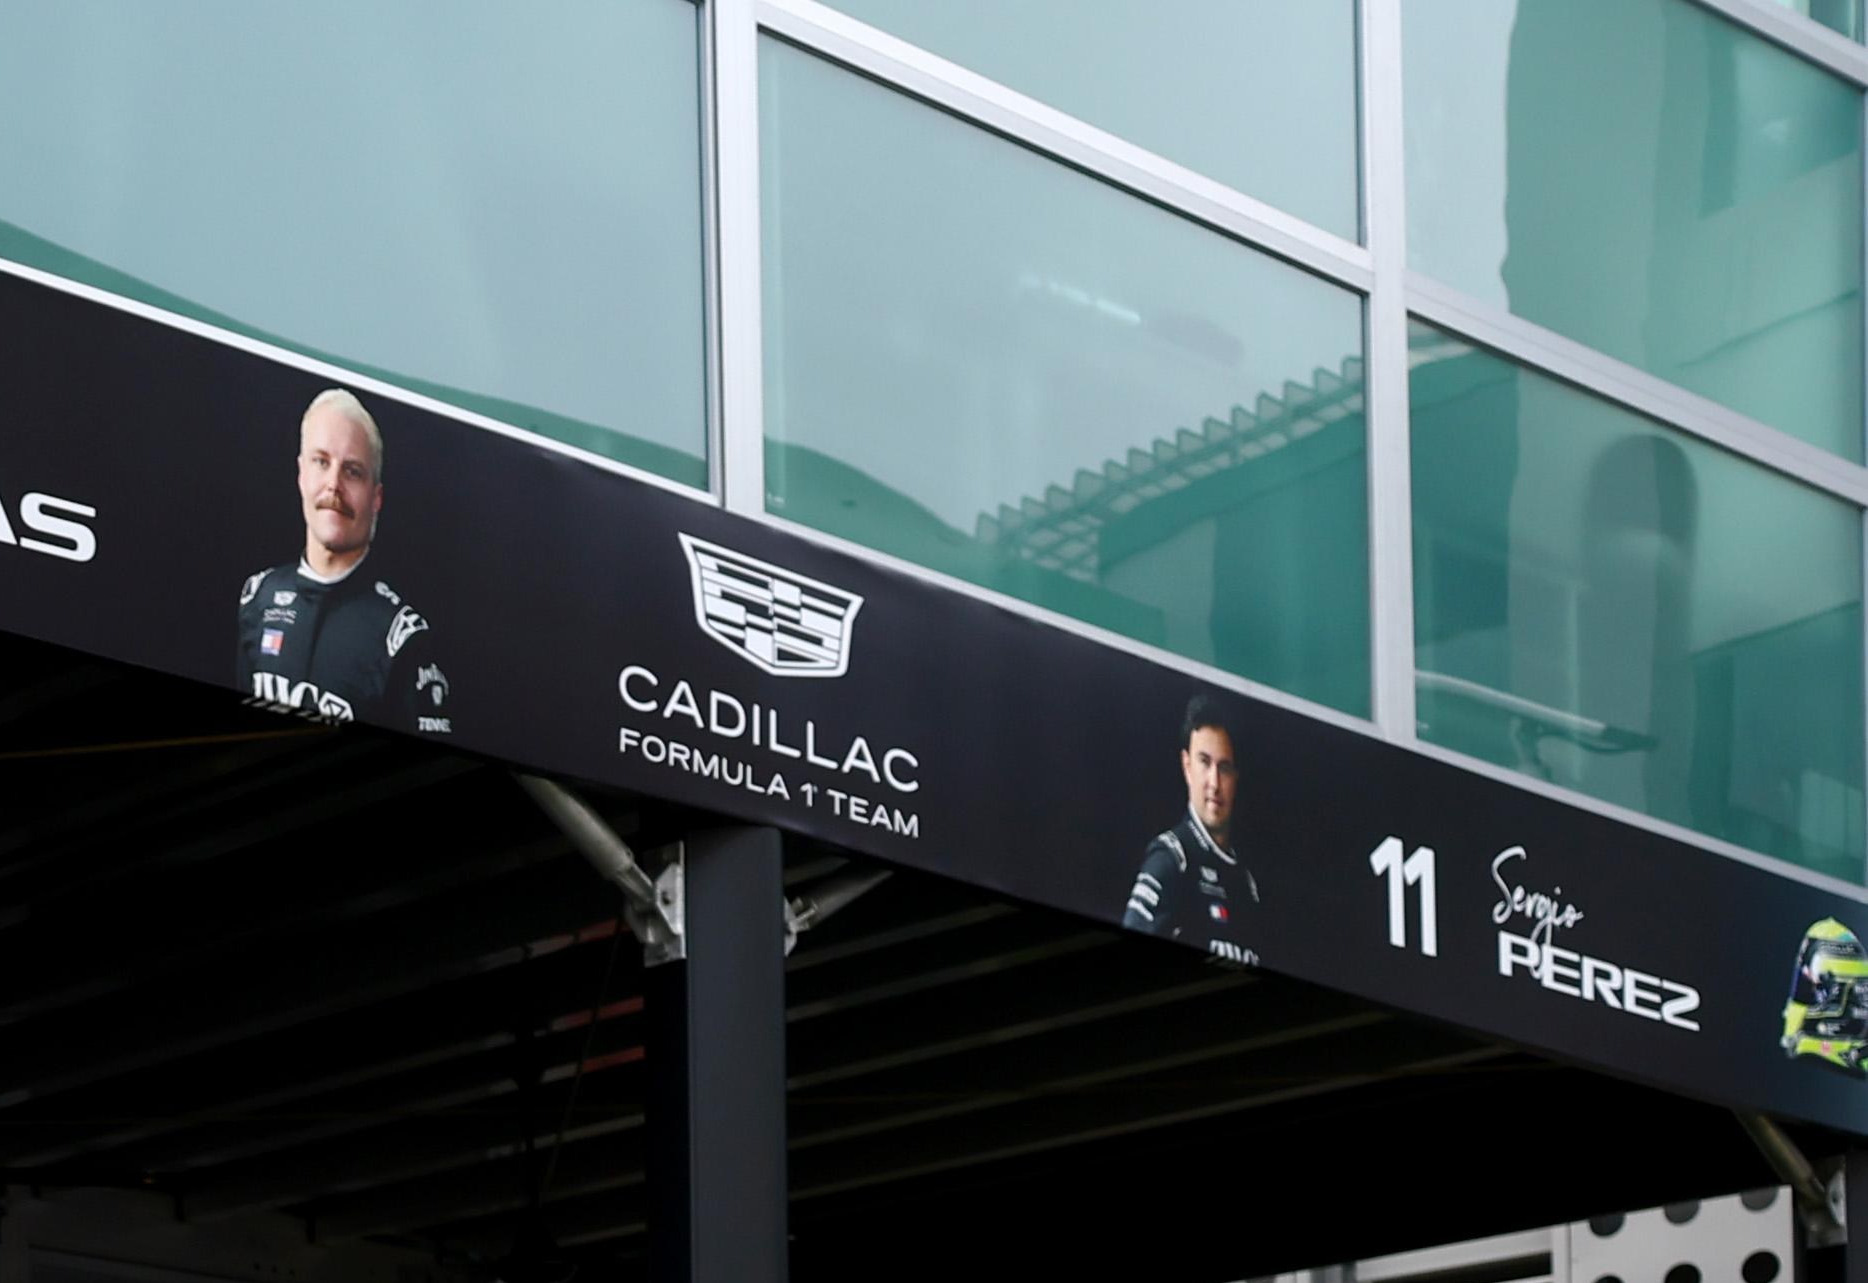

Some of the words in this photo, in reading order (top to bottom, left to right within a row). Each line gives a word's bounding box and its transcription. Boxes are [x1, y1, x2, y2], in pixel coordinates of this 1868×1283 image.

[618, 665, 919, 793] CADILLAC
[619, 727, 790, 801] FORMULA
[800, 782, 818, 808] 1
[826, 788, 920, 838] TEAM
[1369, 835, 1438, 958] 11
[1491, 845, 1584, 980] Sergio
[1498, 930, 1701, 1032] PEREZ
